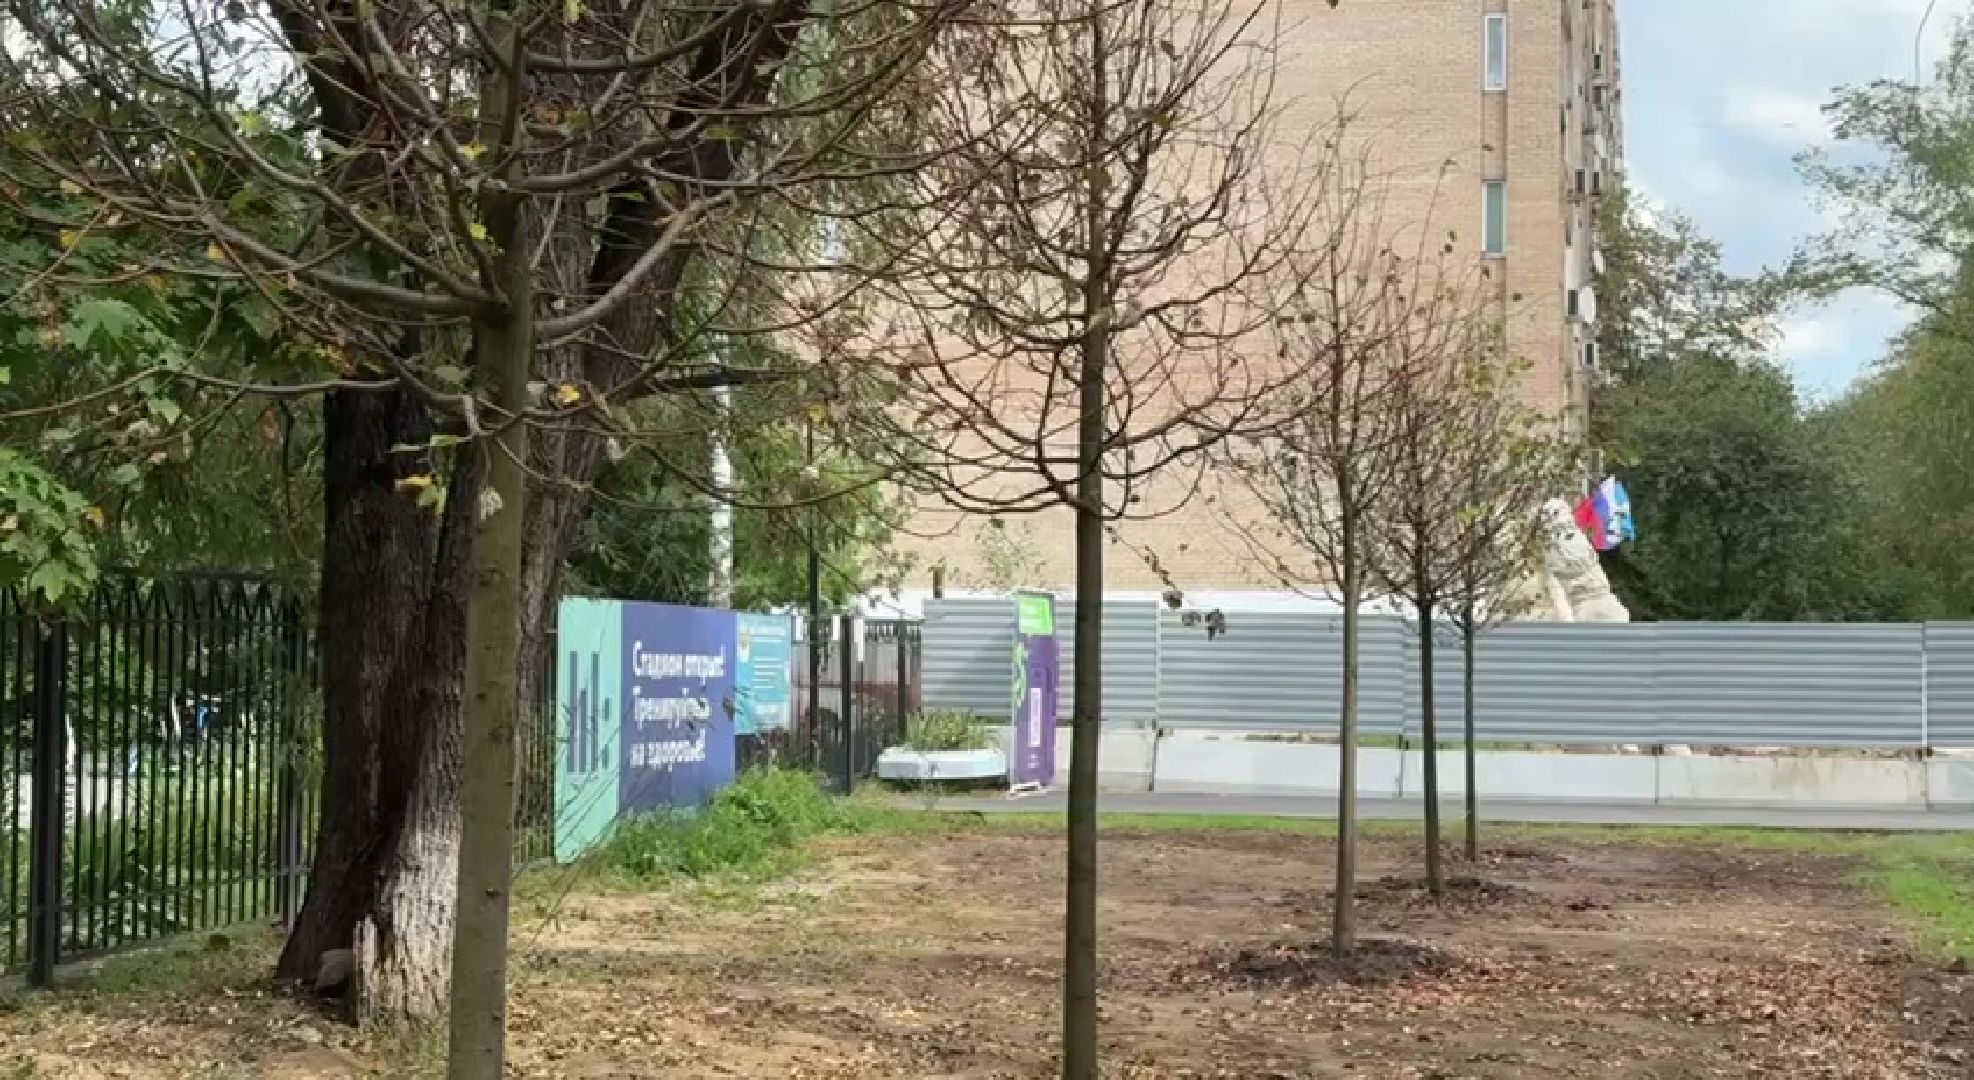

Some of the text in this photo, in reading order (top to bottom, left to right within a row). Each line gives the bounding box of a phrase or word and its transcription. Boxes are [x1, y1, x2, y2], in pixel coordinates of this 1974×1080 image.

[633, 640, 683, 679] Стадион
[685, 644, 727, 686] открыт!
[630, 743, 645, 768] на
